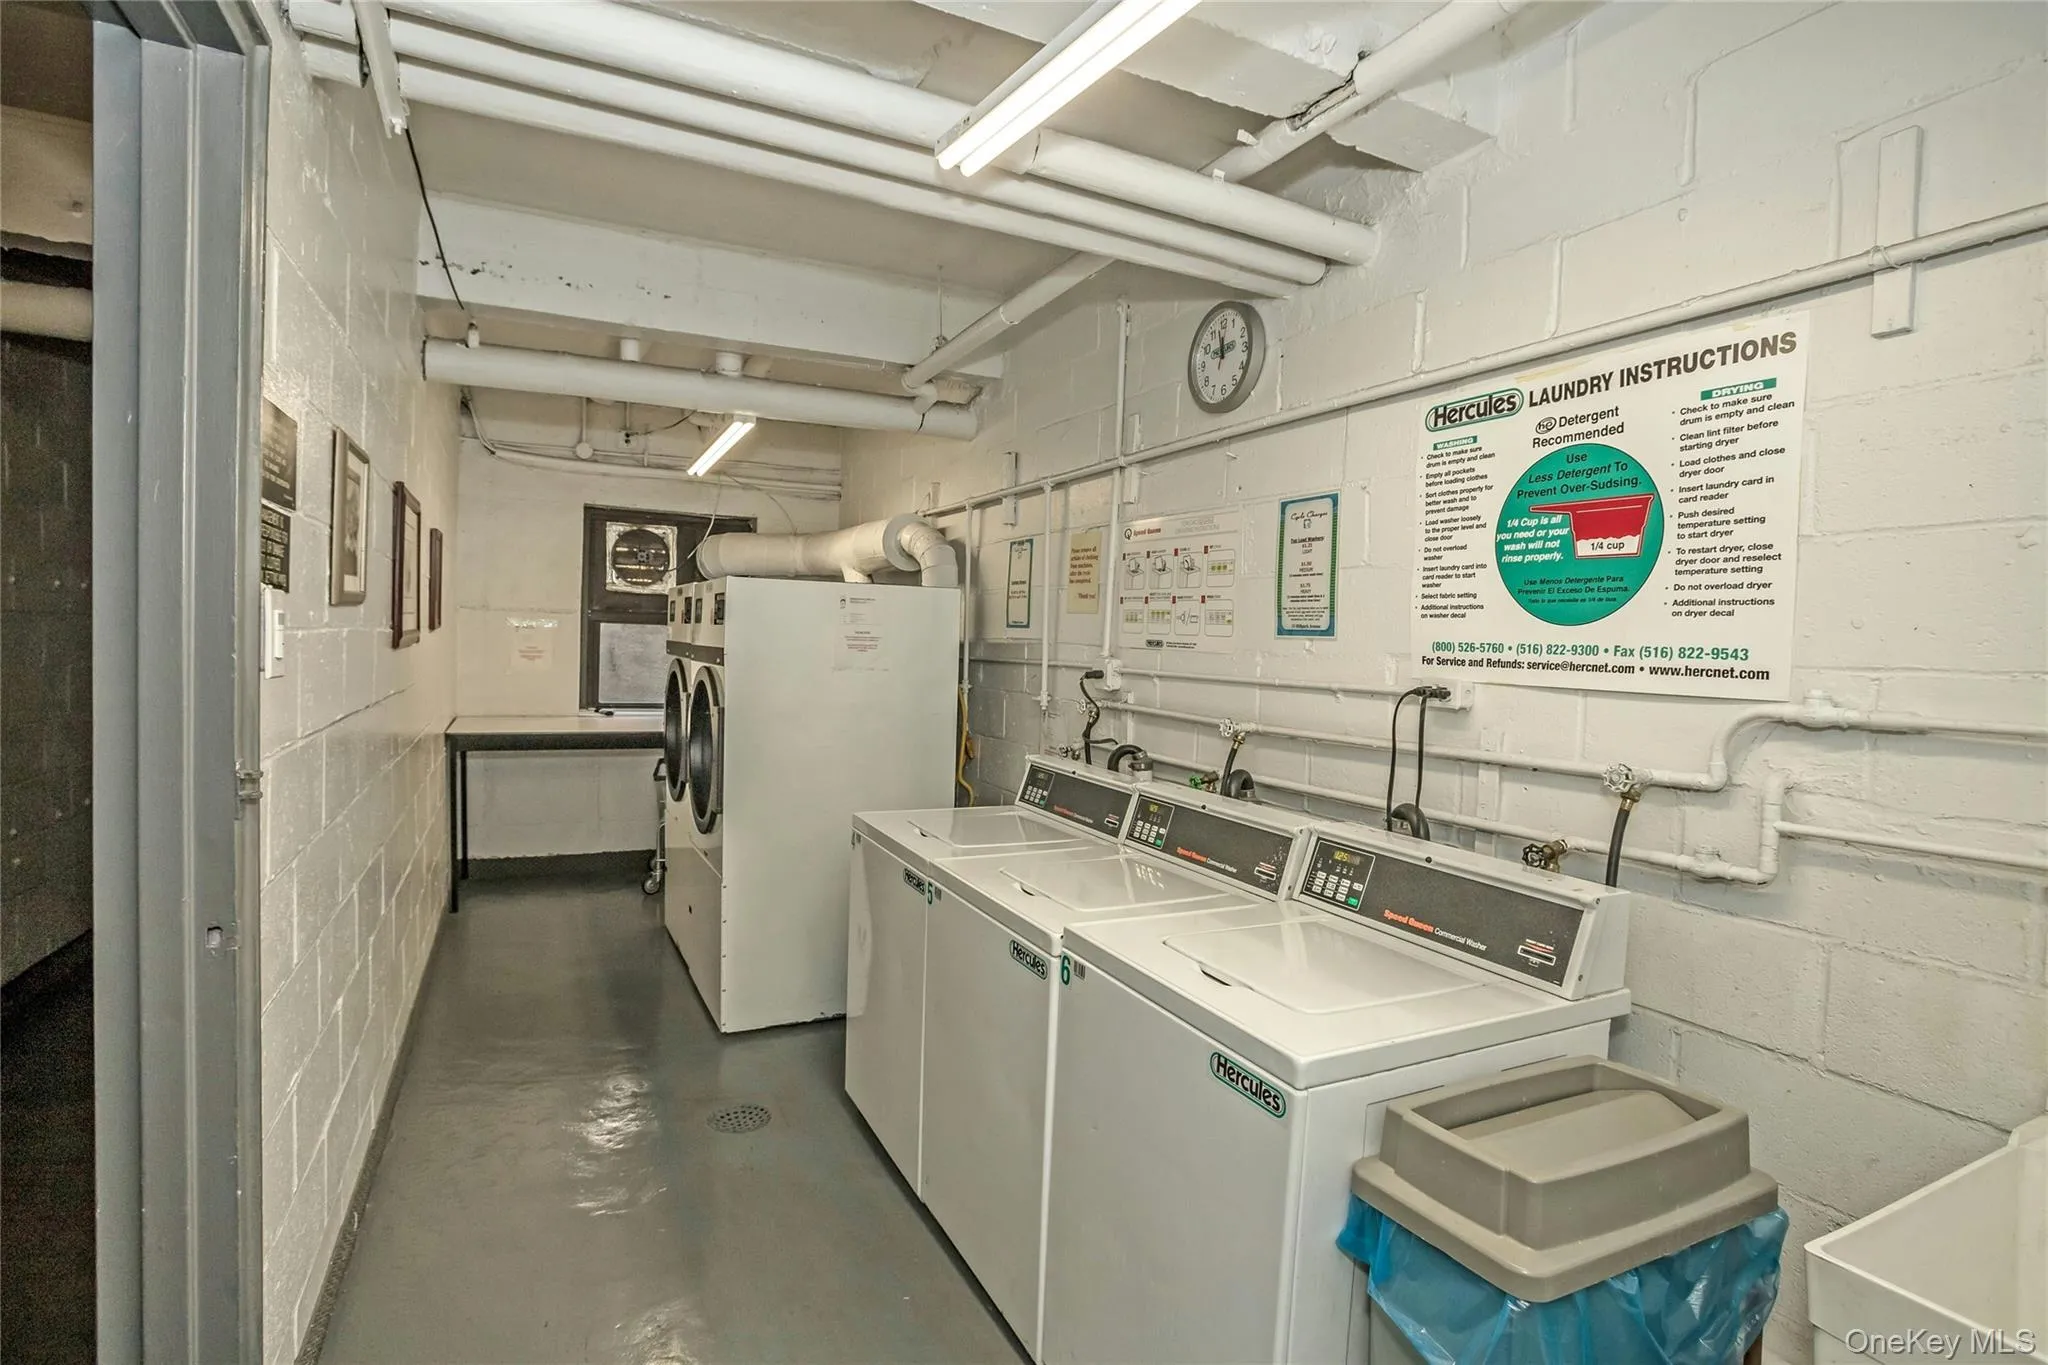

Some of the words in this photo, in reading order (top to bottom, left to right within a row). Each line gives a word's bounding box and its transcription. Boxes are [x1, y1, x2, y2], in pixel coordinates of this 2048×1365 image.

[1433, 393, 1517, 427] Hercules
[1529, 371, 1614, 408] LAUNDRY
[1620, 331, 1797, 388] INSTRUCTIONS
[1712, 381, 1764, 397] DRYING
[1680, 405, 1708, 415] Check
[1722, 398, 1748, 408] make
[1751, 394, 1772, 403] sure
[1559, 406, 1619, 428] Detergent
[1680, 417, 1702, 426] drum
[1715, 409, 1744, 419] empty
[1747, 406, 1764, 415] and
[1768, 401, 1795, 411] clean
[1532, 422, 1625, 448] Recommended
[1680, 433, 1704, 441] Clean
[1723, 426, 1745, 435] filter
[1747, 420, 1779, 431] before
[1680, 441, 1712, 452] starting
[1715, 437, 1739, 447] dryer
[1567, 453, 1587, 464] Use
[1680, 458, 1700, 467] Load
[1703, 453, 1736, 464] clothes
[1739, 450, 1756, 459] and
[1759, 447, 1785, 456] close
[1452, 467, 1475, 476] pockets
[1529, 471, 1553, 484] Less
[1557, 464, 1611, 480] Detergent
[1615, 461, 1628, 471] To
[1679, 469, 1701, 478] dryer
[1704, 466, 1725, 475] door
[1460, 486, 1483, 494] properly
[1517, 485, 1557, 499] Prevent
[1560, 476, 1642, 494] Over-Sudsing.
[1679, 485, 1703, 493] Insert
[1706, 480, 1739, 490] laundry
[1742, 476, 1763, 486] card
[1679, 495, 1697, 503] card
[1700, 492, 1729, 501] reader
[1678, 511, 1699, 519] Push
[1702, 507, 1735, 517] desired
[1507, 518, 1519, 527] 1/4
[1521, 517, 1537, 527] Cup
[1540, 516, 1548, 525] is
[1551, 515, 1562, 523] all
[1678, 519, 1731, 529] temperature
[1734, 515, 1766, 525] setting
[1496, 533, 1512, 542] you
[1514, 529, 1535, 539] need
[1536, 529, 1547, 537] or
[1548, 527, 1570, 538] your
[1710, 529, 1734, 539] dryer
[1504, 541, 1525, 551] wash
[1528, 540, 1543, 549] will
[1545, 540, 1560, 548] not
[1591, 542, 1603, 550] 1/4
[1607, 541, 1625, 551] cup
[1677, 547, 1686, 555] To
[1688, 546, 1717, 554] restart
[1719, 544, 1745, 553] dryer,
[1748, 543, 1774, 551] close
[1502, 553, 1523, 563] rinse
[1524, 552, 1563, 563] properly.
[1676, 558, 1698, 567] dryer
[1700, 556, 1721, 564] door
[1723, 555, 1740, 563] and
[1743, 553, 1782, 562] reselect
[1675, 566, 1728, 576] temperature
[1731, 565, 1763, 574] setting
[1674, 583, 1685, 591] Do
[1705, 582, 1744, 590] overload
[1746, 581, 1772, 590] dryer
[1718, 598, 1775, 606] instructions
[1685, 610, 1707, 618] dryer
[1432, 641, 1455, 654] (800)
[1458, 642, 1504, 654] 526-5760
[1516, 643, 1543, 657] (516)
[1546, 644, 1599, 656] 822-9300
[1613, 645, 1635, 657] Fax
[1639, 646, 1673, 661] (516)
[1678, 646, 1749, 661] 822-9543
[1422, 656, 1434, 665] For
[1436, 656, 1466, 667] Service
[1468, 657, 1484, 667] and
[1486, 658, 1525, 669] Refunds:
[1527, 660, 1635, 674] service@hercnet.com
[1649, 665, 1770, 680] www.hercnet.com
[904, 869, 925, 893] Hercules
[927, 882, 933, 905] 5
[1383, 909, 1409, 924] Speed
[1408, 917, 1434, 933] Queen
[1434, 927, 1466, 945] Commercial
[1466, 938, 1488, 951] Washer
[1012, 942, 1047, 976] Hercules
[1061, 955, 1071, 986] 6
[1216, 1054, 1281, 1112] Hercules
